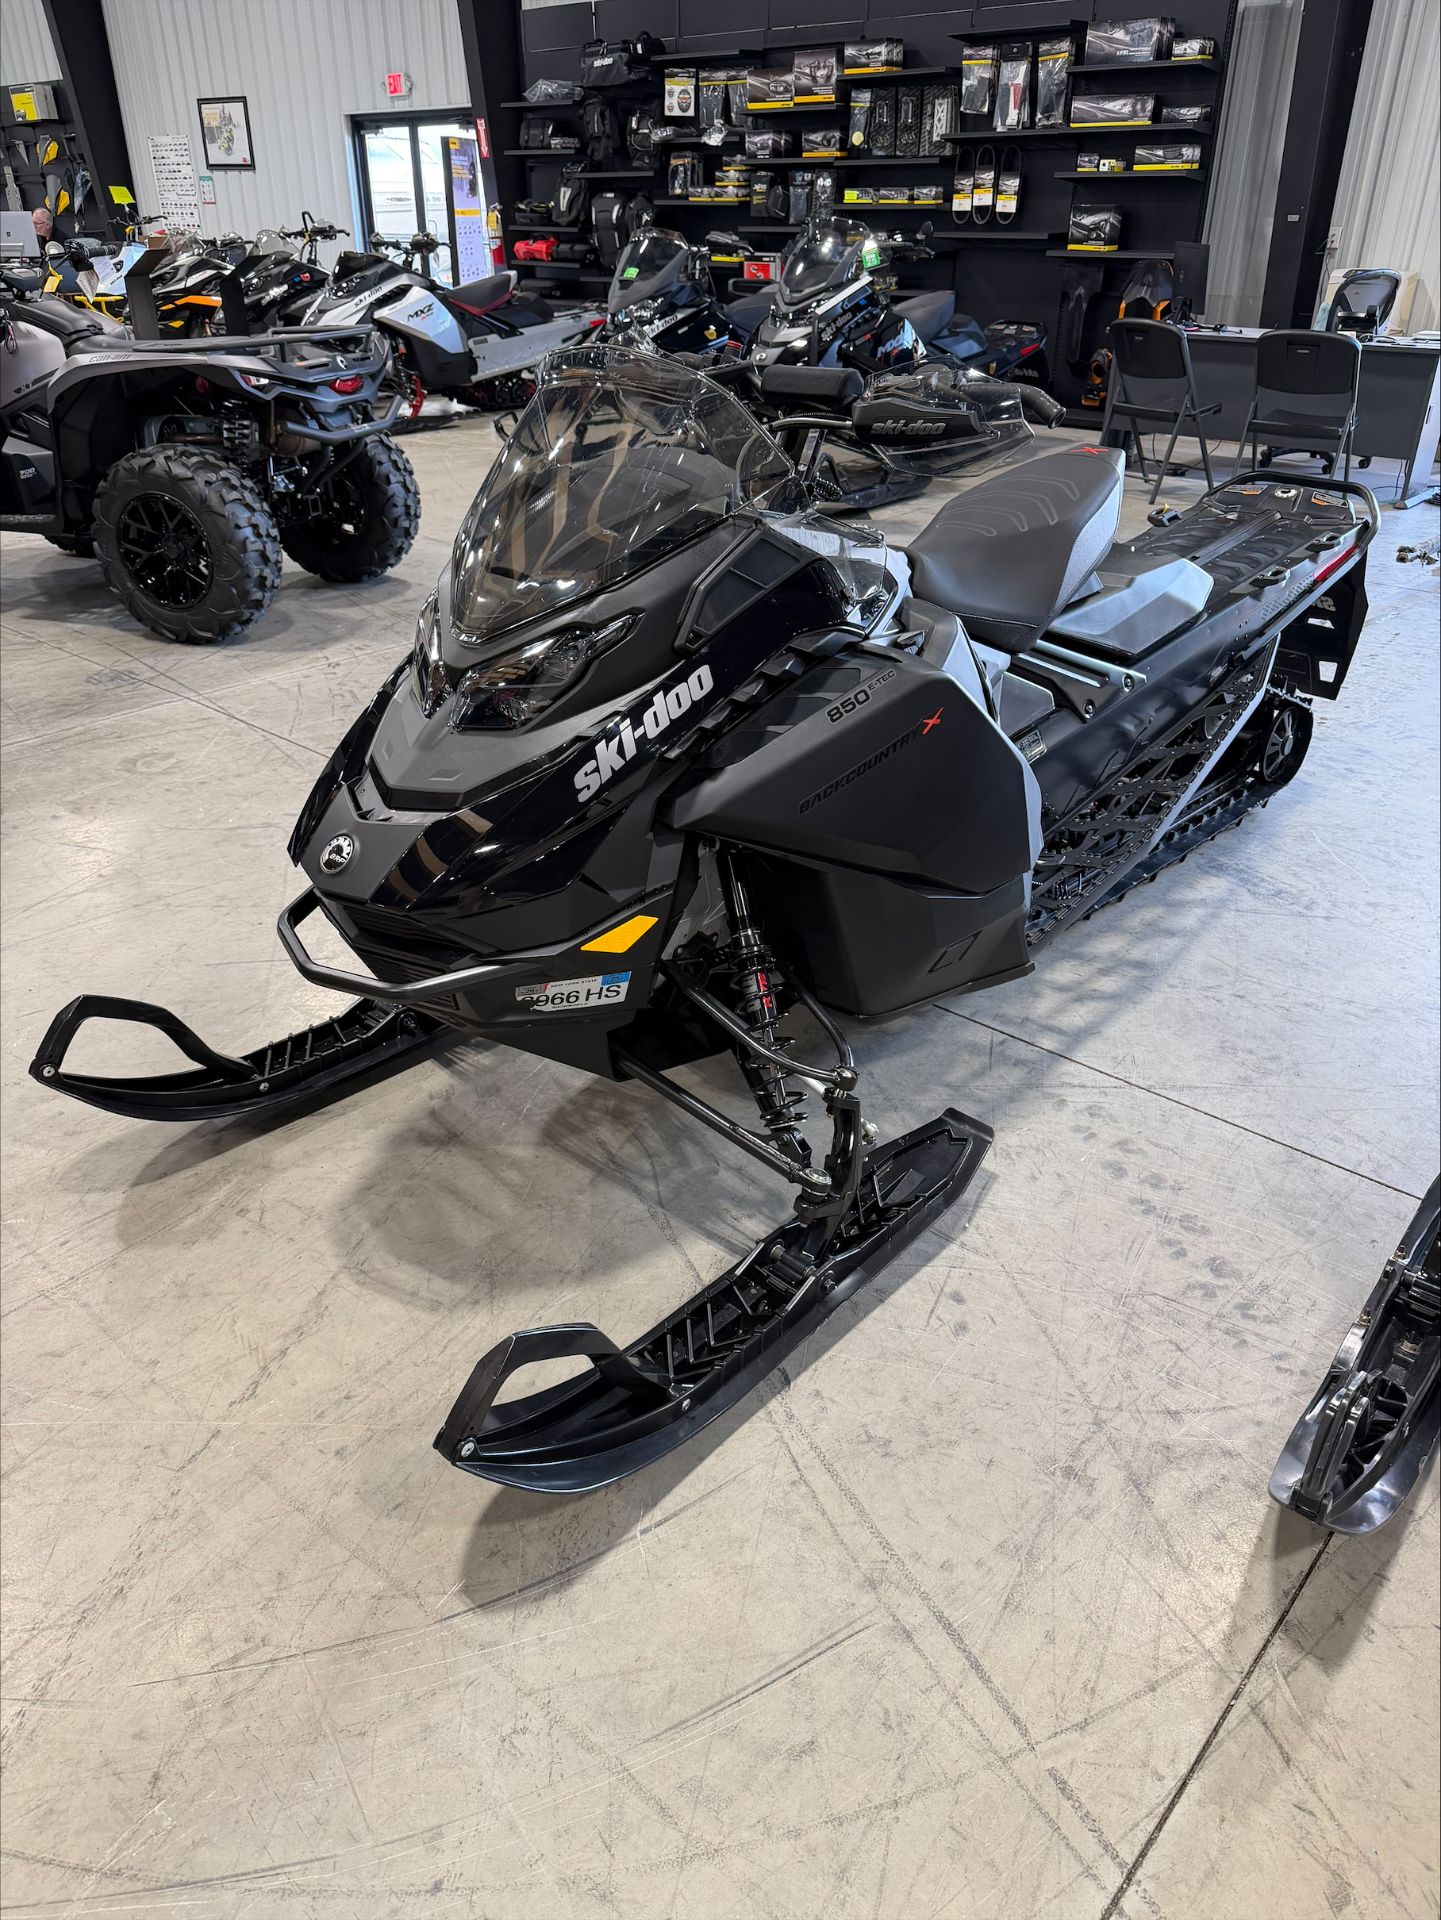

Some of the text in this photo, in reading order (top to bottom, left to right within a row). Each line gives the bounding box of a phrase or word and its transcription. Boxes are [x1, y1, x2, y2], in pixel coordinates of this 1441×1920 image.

[870, 419, 947, 436] ski-doo
[826, 670, 896, 724] 850 E-TEC
[573, 664, 714, 803] ski-doo
[799, 706, 944, 815] BACKCOUNTRY X
[329, 853, 346, 863] BRP
[585, 984, 622, 1002] HS
